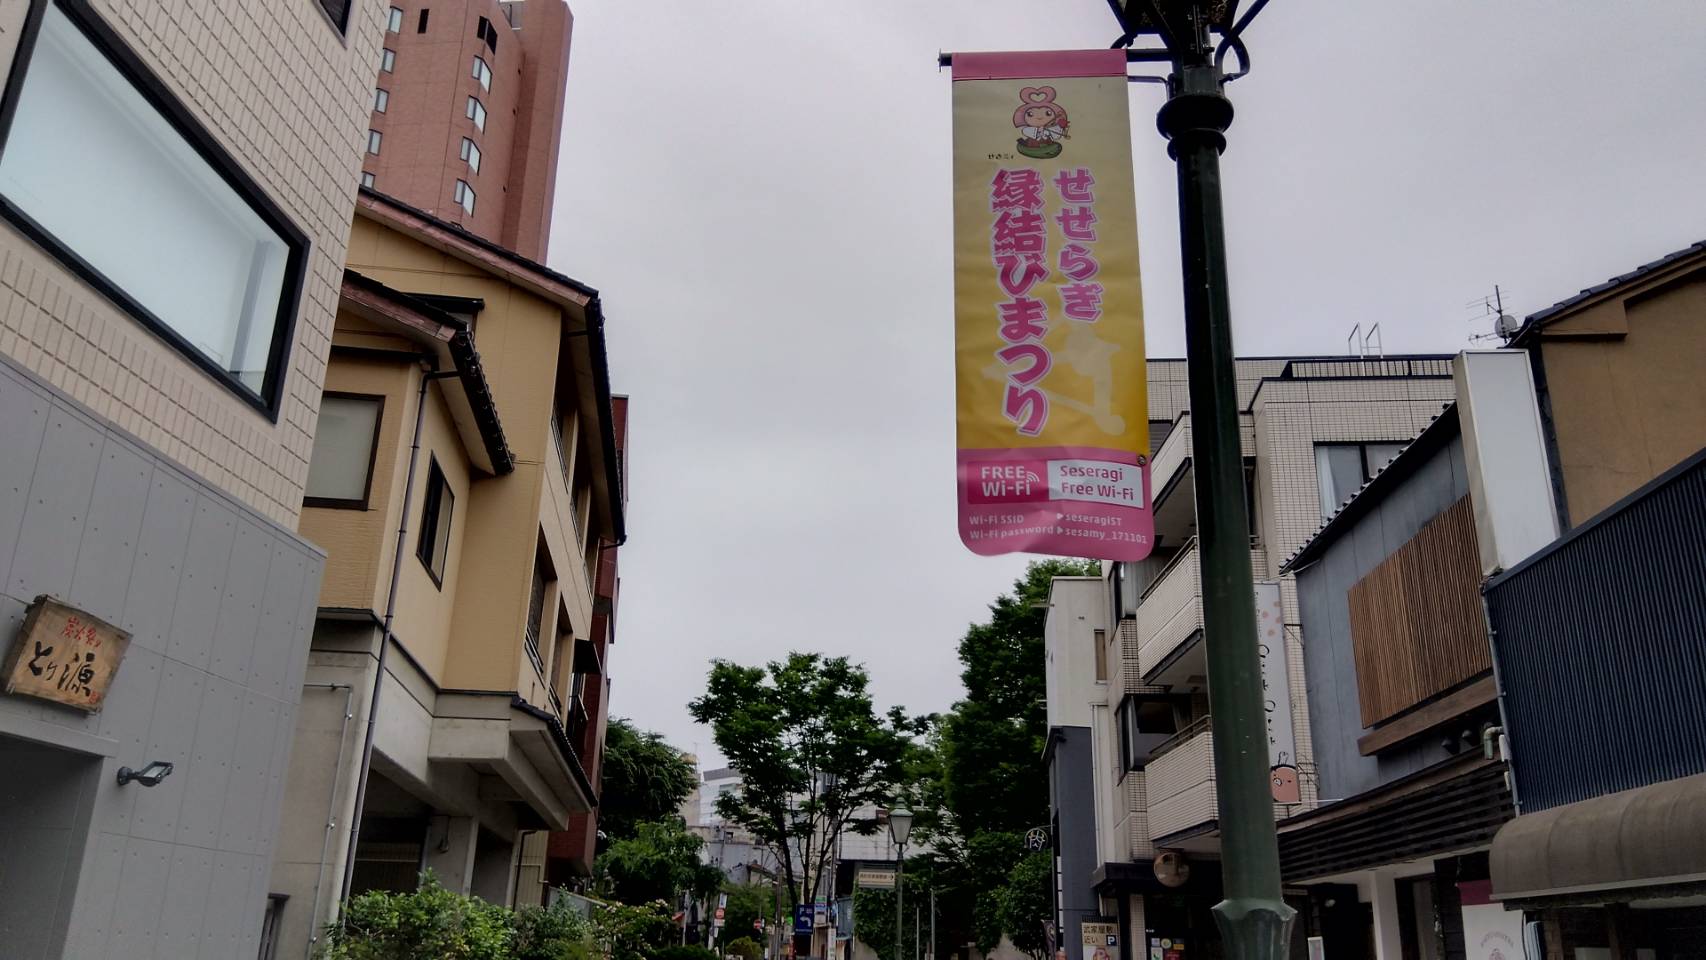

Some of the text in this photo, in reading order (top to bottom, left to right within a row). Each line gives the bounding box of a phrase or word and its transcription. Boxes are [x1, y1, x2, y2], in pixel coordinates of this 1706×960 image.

[1053, 168, 1103, 322] せせらぎ
[990, 168, 1051, 436] 縁結びまつり
[981, 465, 1026, 480] FREE
[1060, 465, 1123, 482] Seseragi
[982, 480, 1031, 497] Wi-Fi
[1061, 482, 1134, 501] Free Wi-Fi
[969, 515, 998, 525] Wi-Fi
[1000, 514, 1025, 525] SSID
[970, 528, 999, 540] Wi-Fi
[1000, 525, 1054, 540] password
[1107, 936, 1115, 945] P
